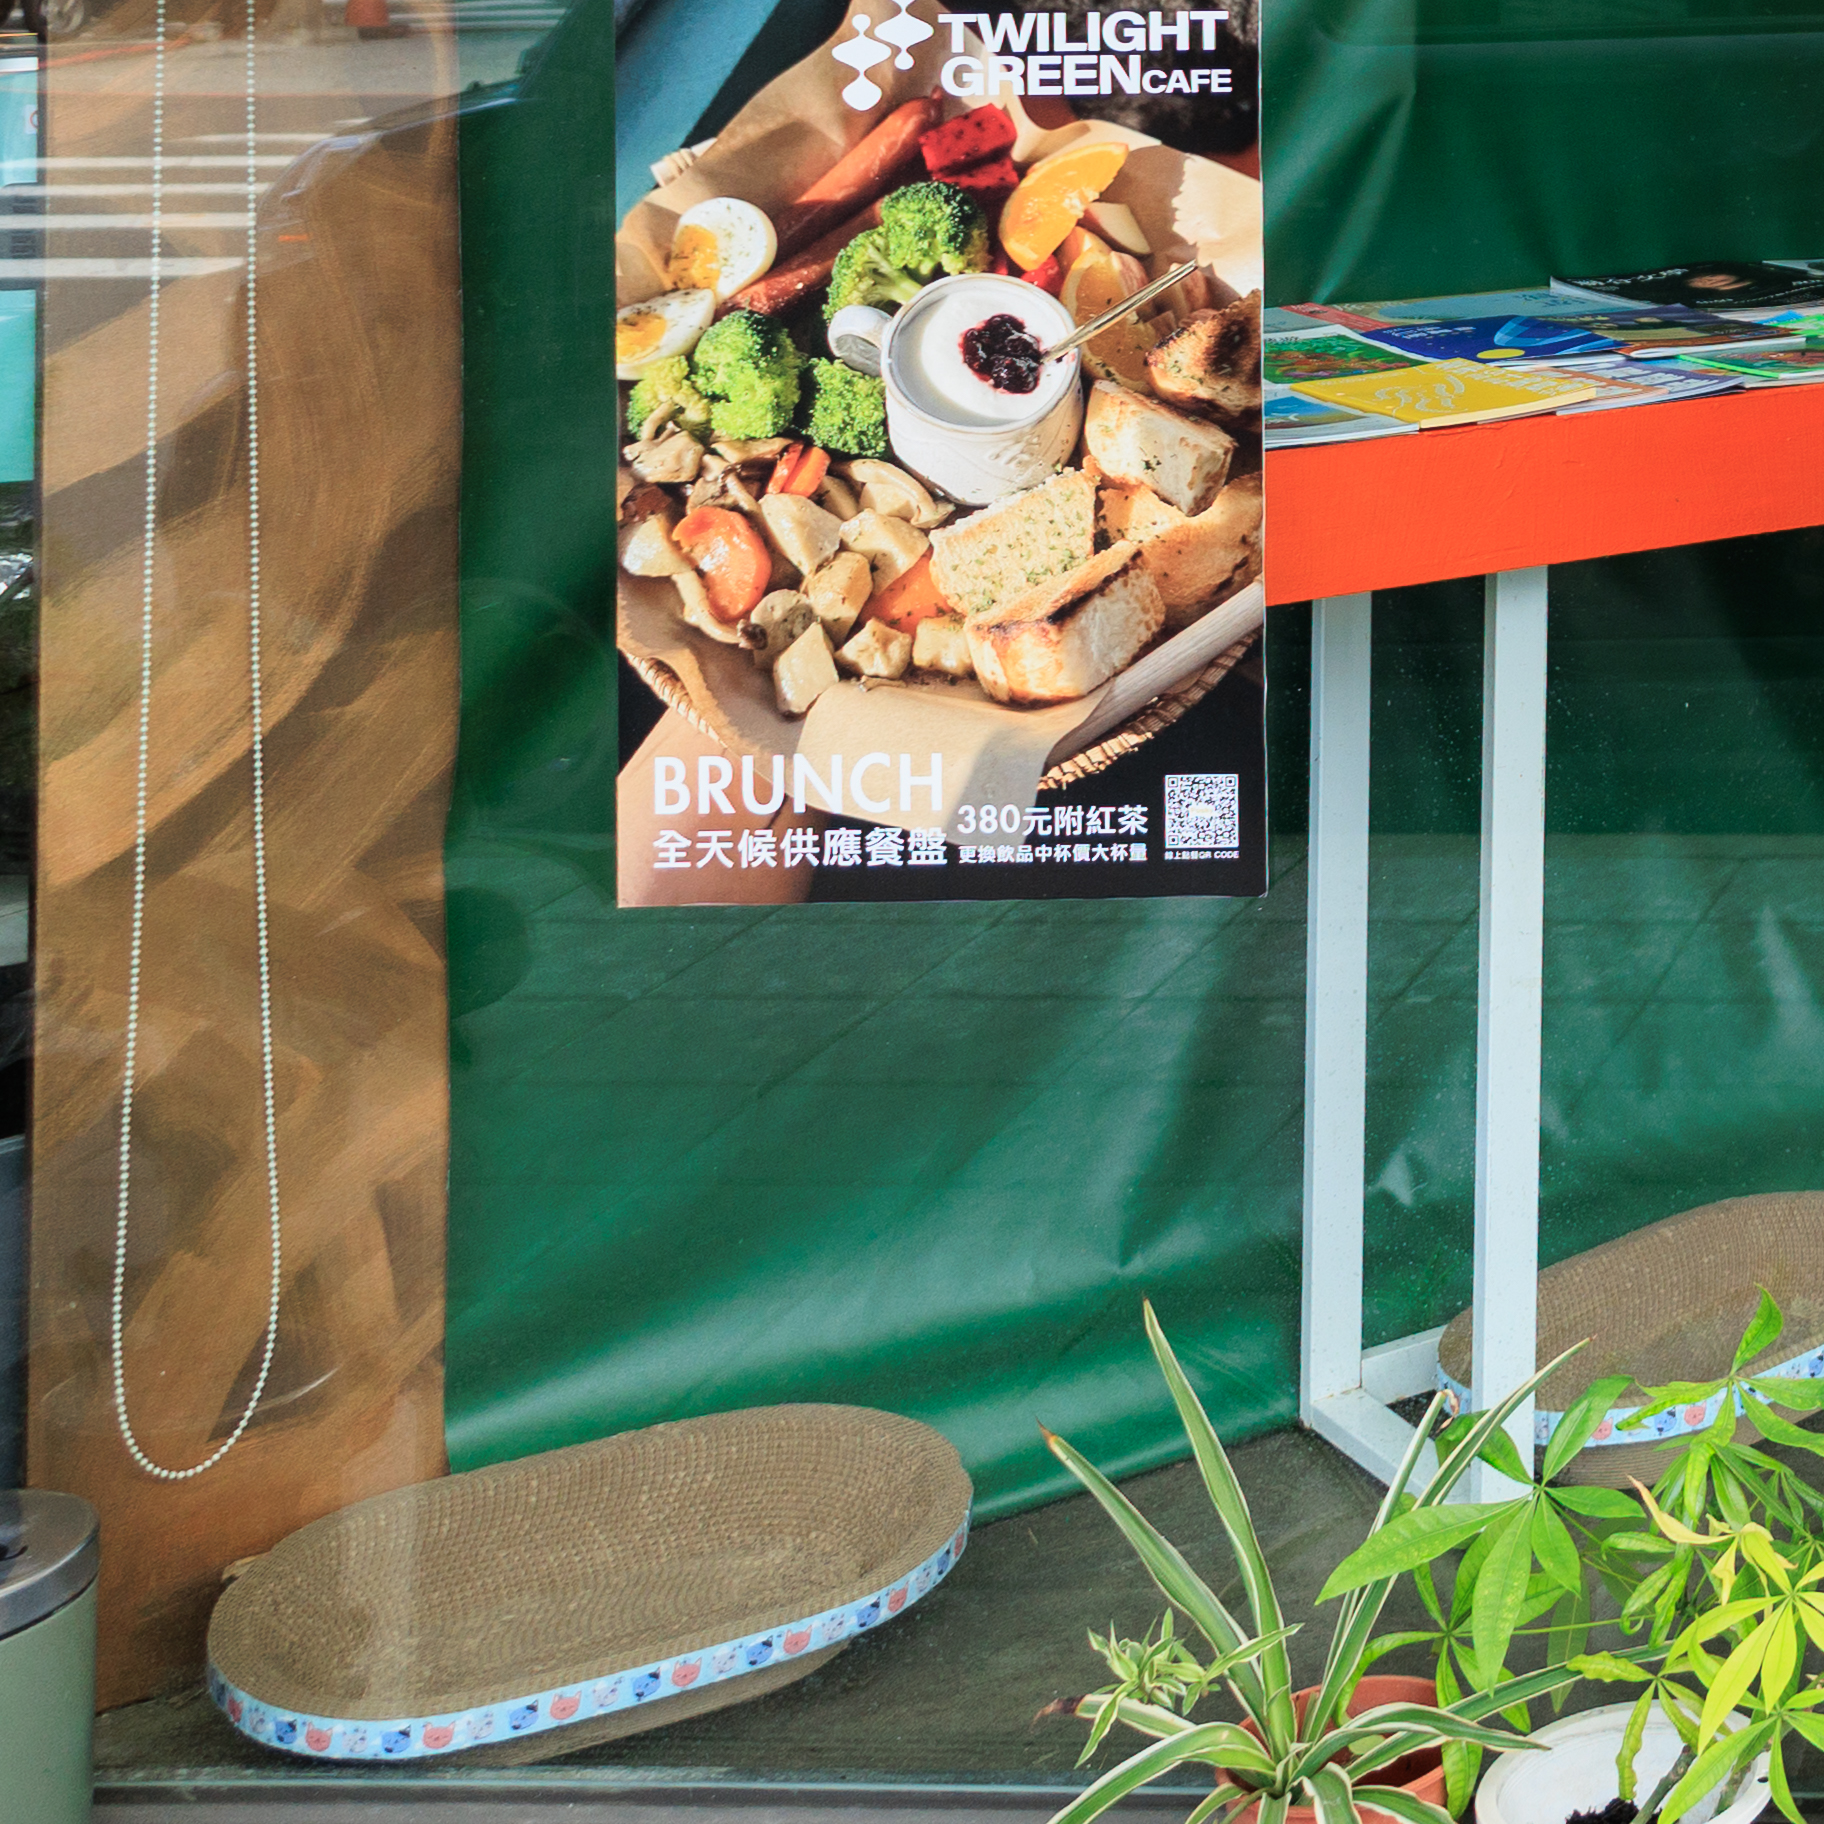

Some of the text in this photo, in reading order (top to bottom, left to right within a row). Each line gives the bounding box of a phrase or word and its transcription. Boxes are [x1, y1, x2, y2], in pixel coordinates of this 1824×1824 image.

[937, 10, 1230, 54] TWILIGHT
[653, 752, 943, 816] BRUNCH
[957, 804, 1148, 836] 380元附紅茶
[653, 826, 948, 870] 全天候供應餐盤
[959, 843, 1148, 863] 更換飲品中杯價大杯量
